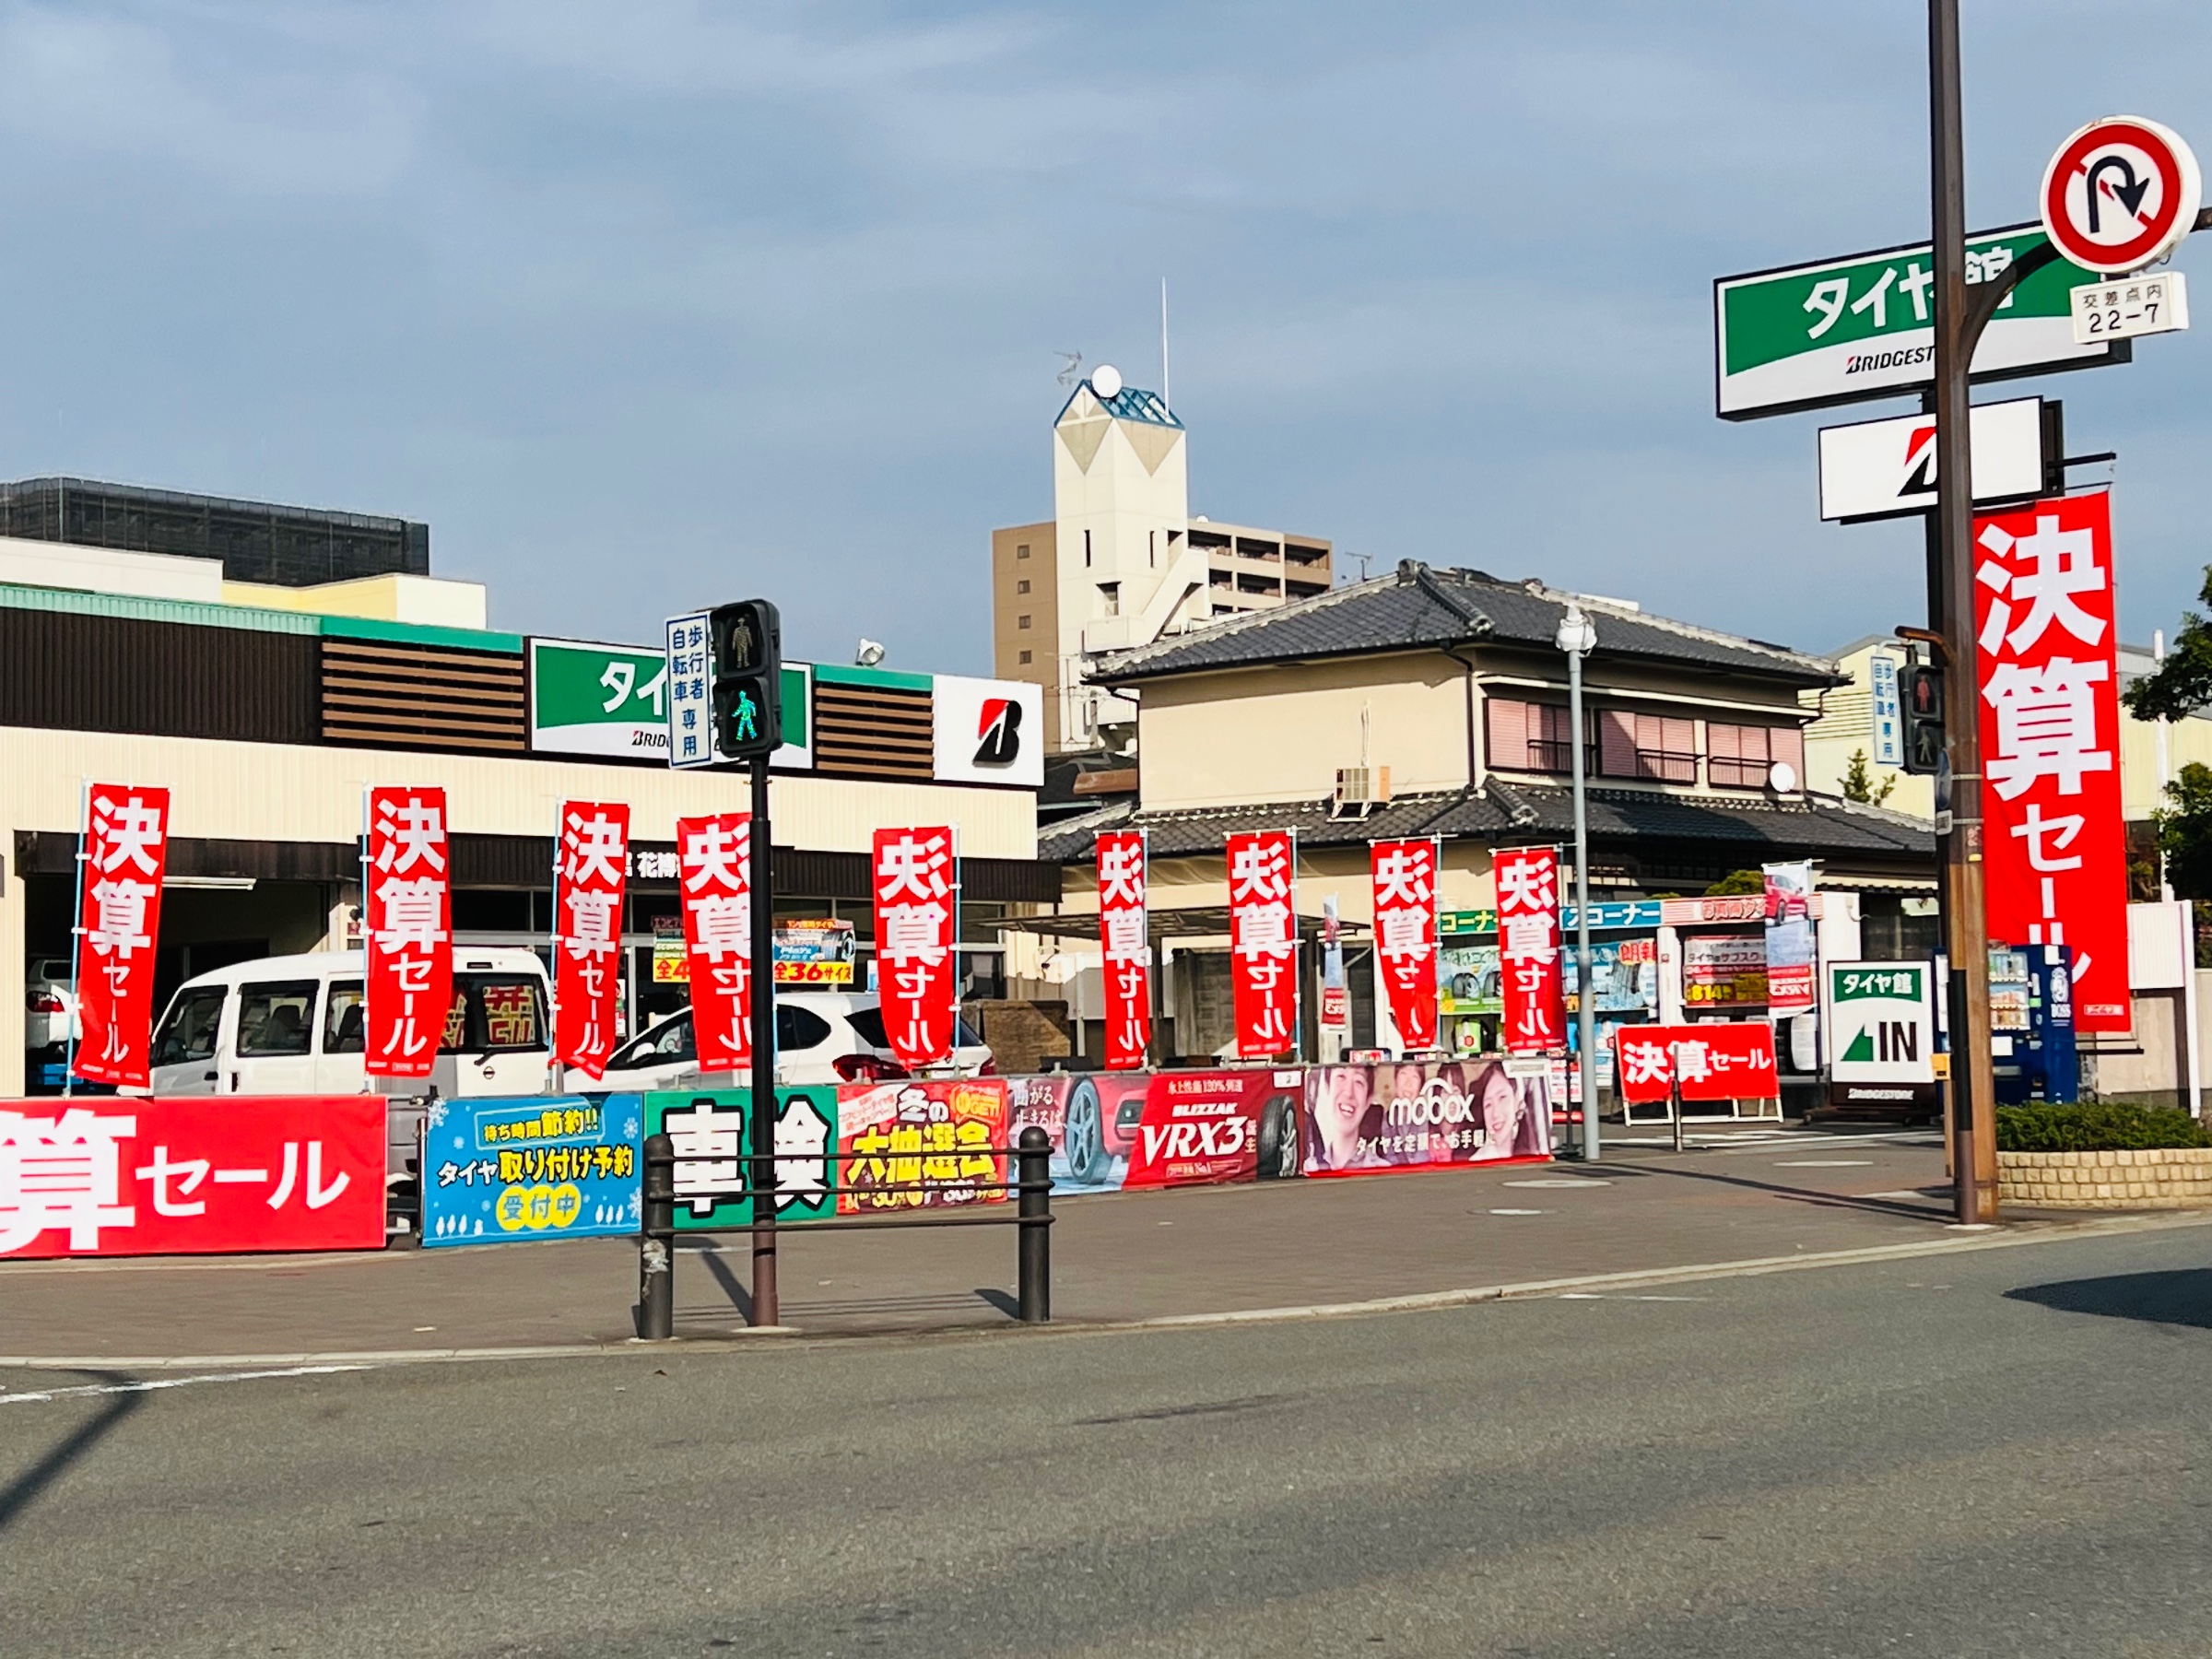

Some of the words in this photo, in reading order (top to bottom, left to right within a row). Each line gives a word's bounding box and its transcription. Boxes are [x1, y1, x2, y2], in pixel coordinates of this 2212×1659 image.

[2083, 284, 2163, 309] 交差点内
[2088, 303, 2159, 334] 22-7
[672, 629, 688, 701] 自転車
[688, 625, 705, 700] 歩行者
[682, 708, 697, 757] 専用
[637, 852, 681, 877] 花博
[89, 797, 163, 1062] 決算セール
[375, 797, 448, 1058] 決算セール
[563, 811, 624, 1055] 決算セール
[1442, 910, 1499, 932] コーナ
[1563, 903, 1661, 927] スコーナー
[774, 961, 852, 982] 全36サイズ
[1842, 973, 1912, 994] タイヤ館
[1879, 1021, 1918, 1062] IN
[1622, 1041, 1771, 1084] 決算セール
[899, 1088, 949, 1123] 冬の
[1172, 1102, 1238, 1117] BLIZZAK
[1388, 1078, 1476, 1126] mobox
[847, 1120, 996, 1184] 大抽選会
[1141, 1116, 1248, 1167] VRX3
[438, 1146, 634, 1187] タイヤ取り付け予約
[502, 1193, 576, 1221] 受付中
